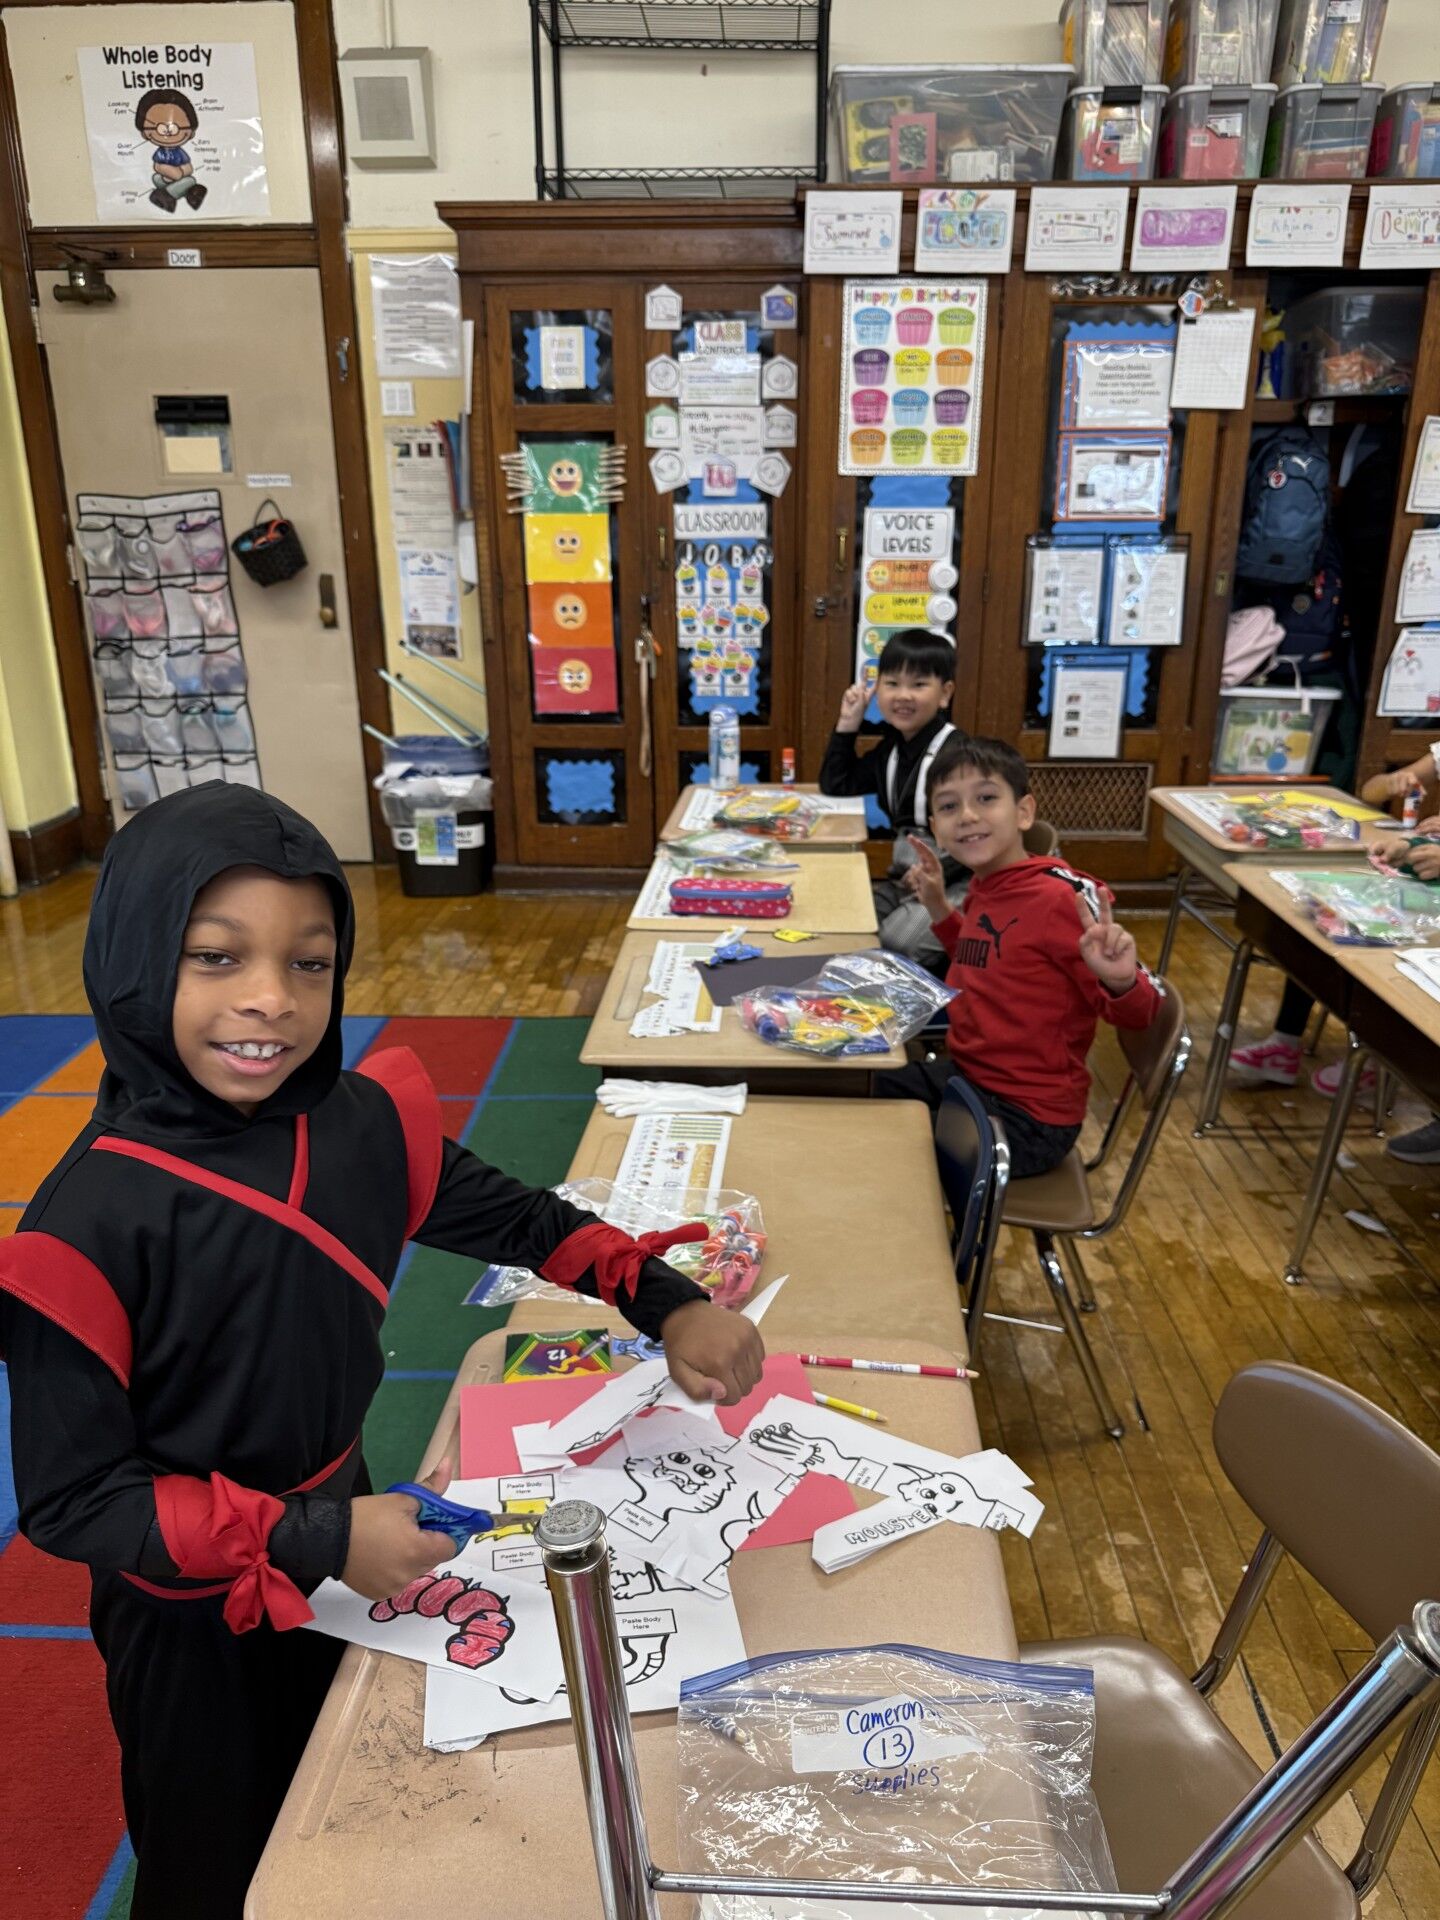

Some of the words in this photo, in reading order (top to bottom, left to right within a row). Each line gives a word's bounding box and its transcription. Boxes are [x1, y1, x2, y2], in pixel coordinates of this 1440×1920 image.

[102, 46, 159, 65] Whole
[165, 44, 212, 67] Body
[122, 70, 204, 91] Listening
[170, 252, 197, 265] Door
[854, 288, 898, 306] Happy
[916, 288, 977, 307] Birthday
[699, 322, 742, 342] CLASS
[1317, 403, 1328, 422] 2
[675, 511, 766, 532] CLASSROOM
[882, 515, 935, 531] VOICE
[681, 543, 767, 568] JOBS
[882, 537, 932, 554] LEVELS
[956, 937, 991, 968] UMA
[547, 1347, 568, 1361] 12
[844, 1504, 943, 1545] MONSTER
[643, 1616, 661, 1624] Body
[846, 1701, 925, 1735] Cameron
[881, 1733, 908, 1760] 13
